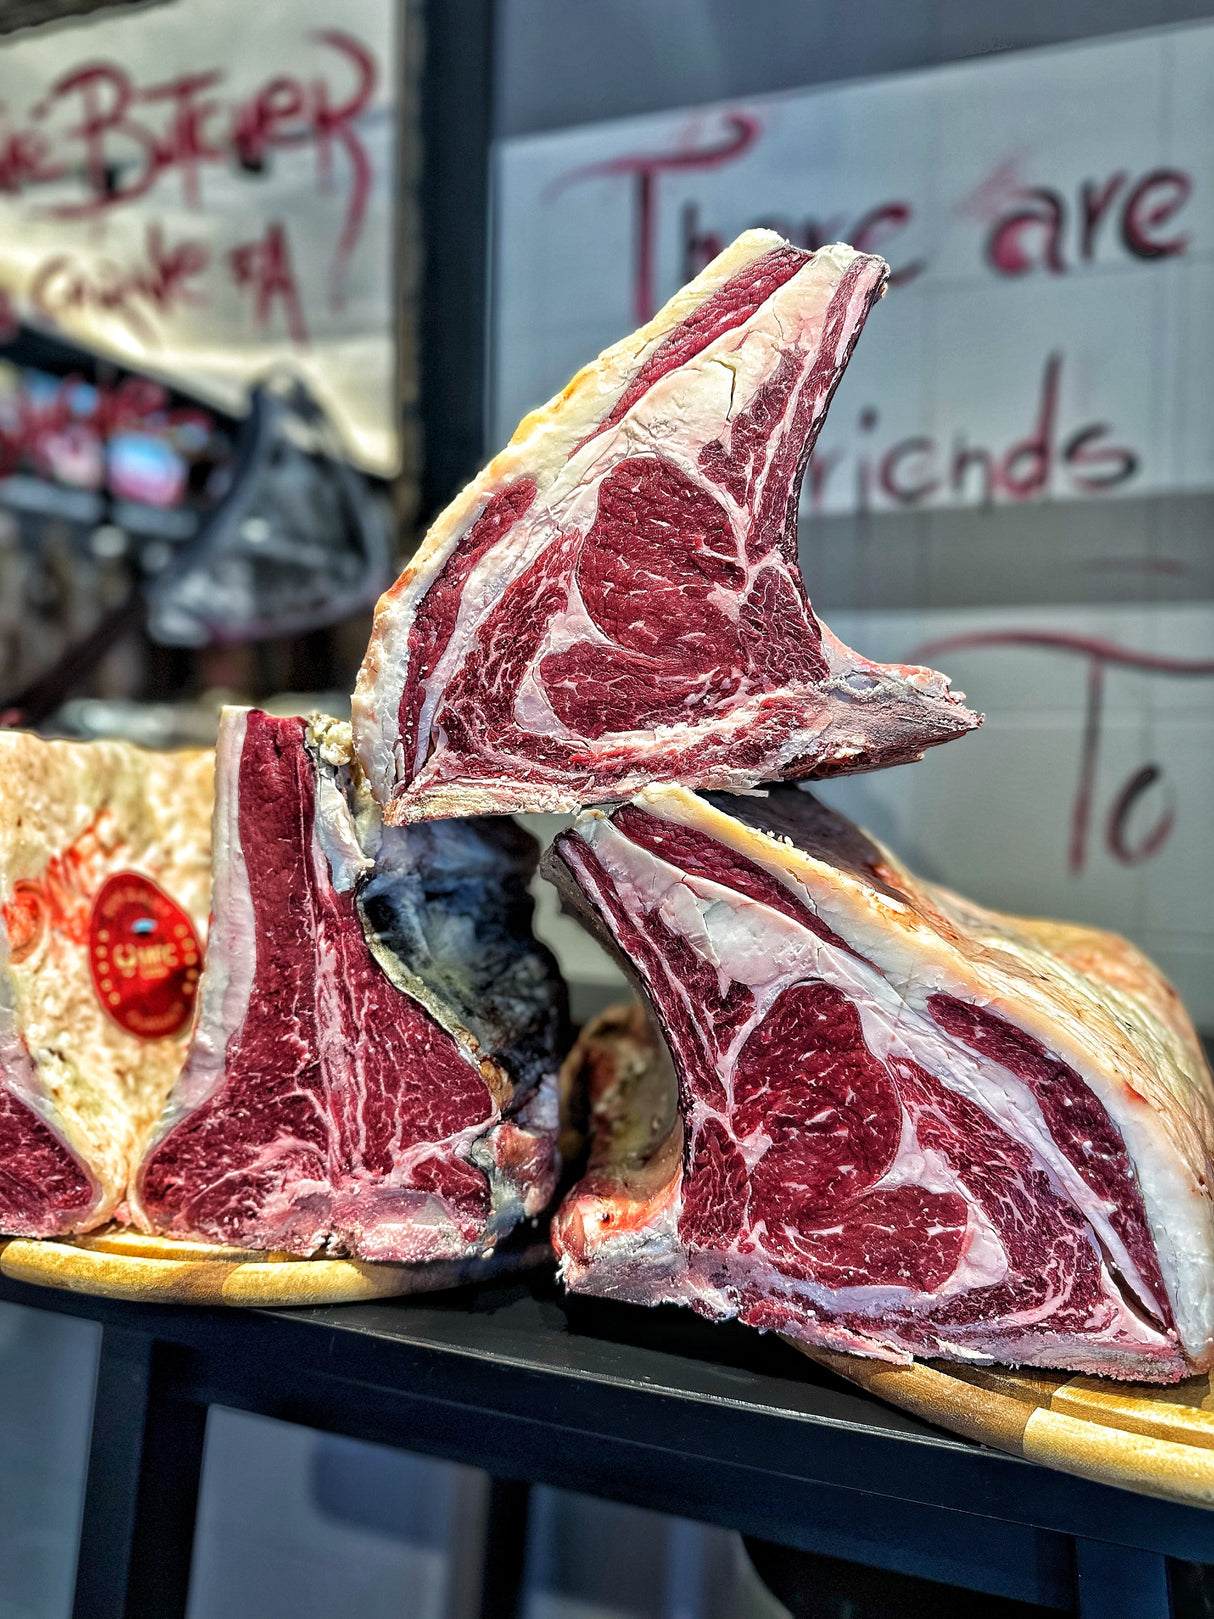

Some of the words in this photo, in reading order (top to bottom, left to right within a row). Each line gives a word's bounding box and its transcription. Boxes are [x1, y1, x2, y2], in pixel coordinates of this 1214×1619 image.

[982, 167, 1193, 277] are
[807, 348, 1139, 517] riends
[900, 627, 1214, 882] To
